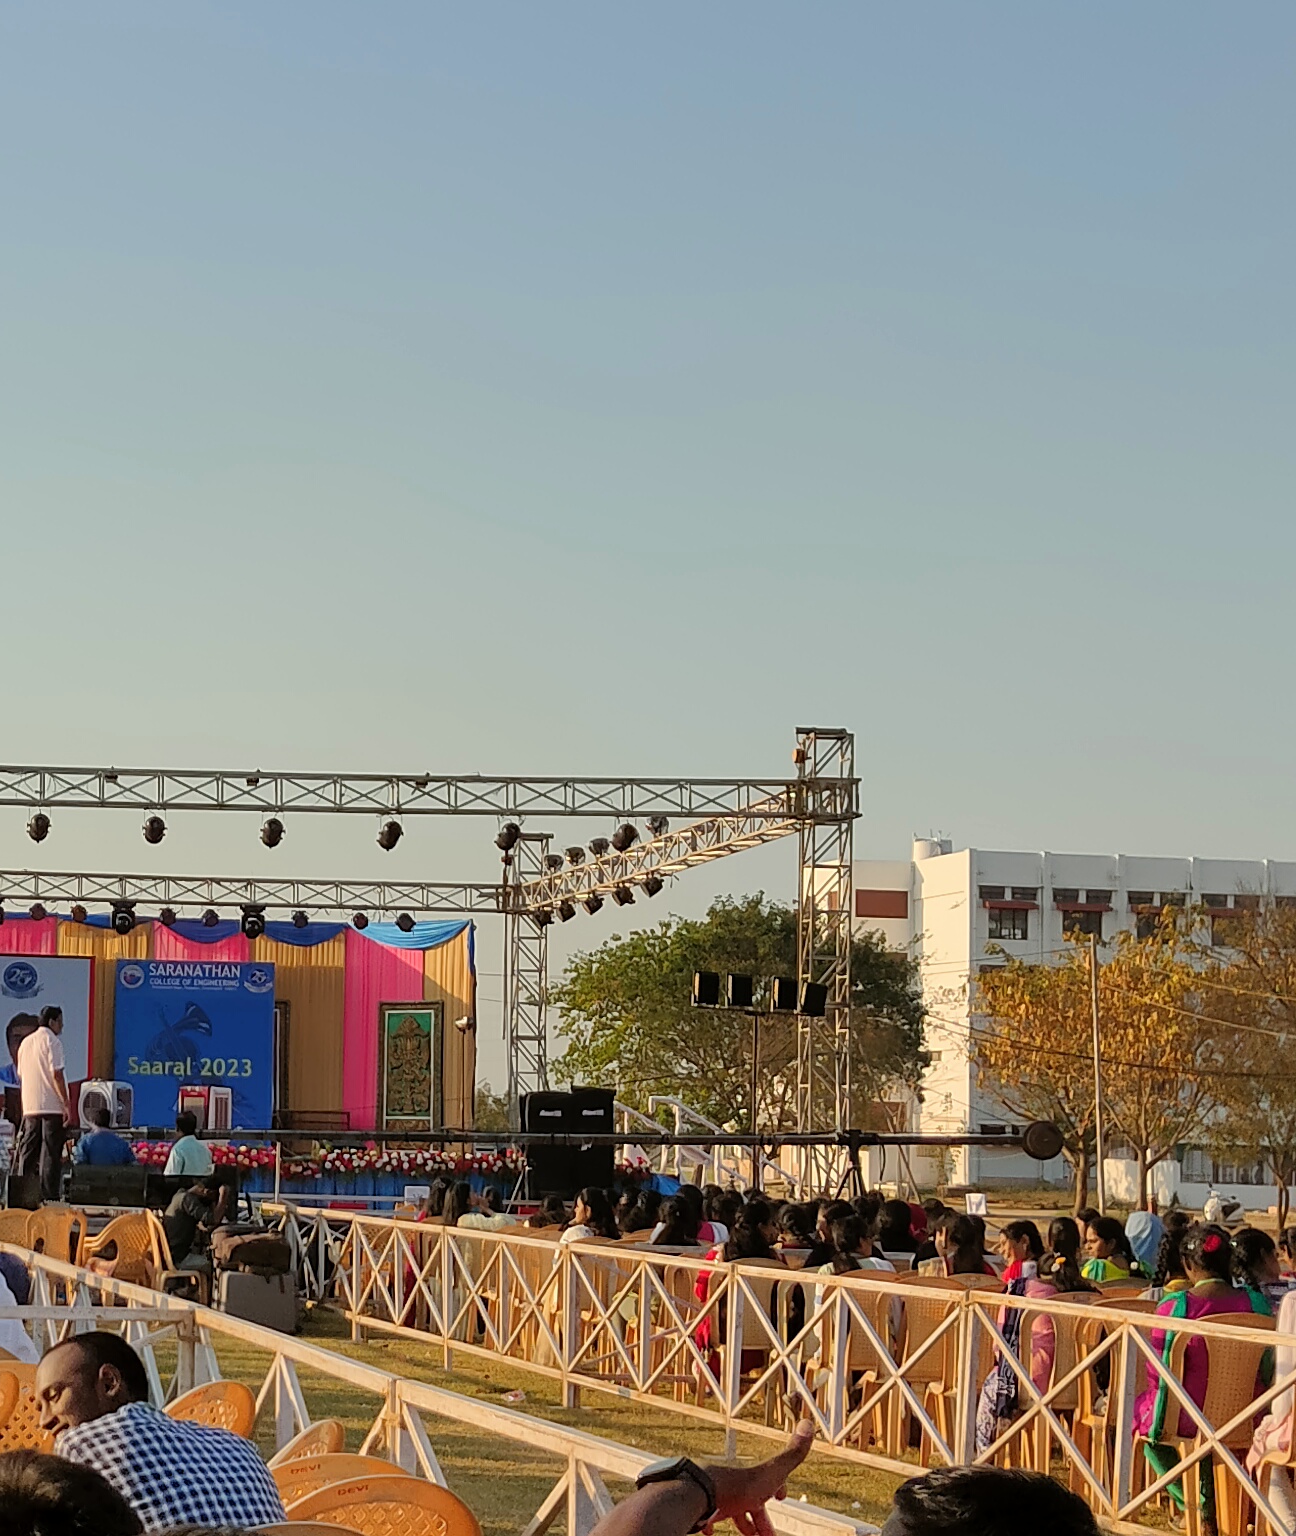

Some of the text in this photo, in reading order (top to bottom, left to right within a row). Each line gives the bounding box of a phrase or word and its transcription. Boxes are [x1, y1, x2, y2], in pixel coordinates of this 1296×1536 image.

[149, 963, 240, 978] SARANATHAN
[149, 977, 180, 986] COLLEGE
[182, 978, 191, 986] OF
[193, 979, 240, 987] ENGINEERING
[128, 1056, 252, 1079] Saaral 2023
[290, 1463, 321, 1475] DEVI
[337, 1484, 369, 1496] DEVI
